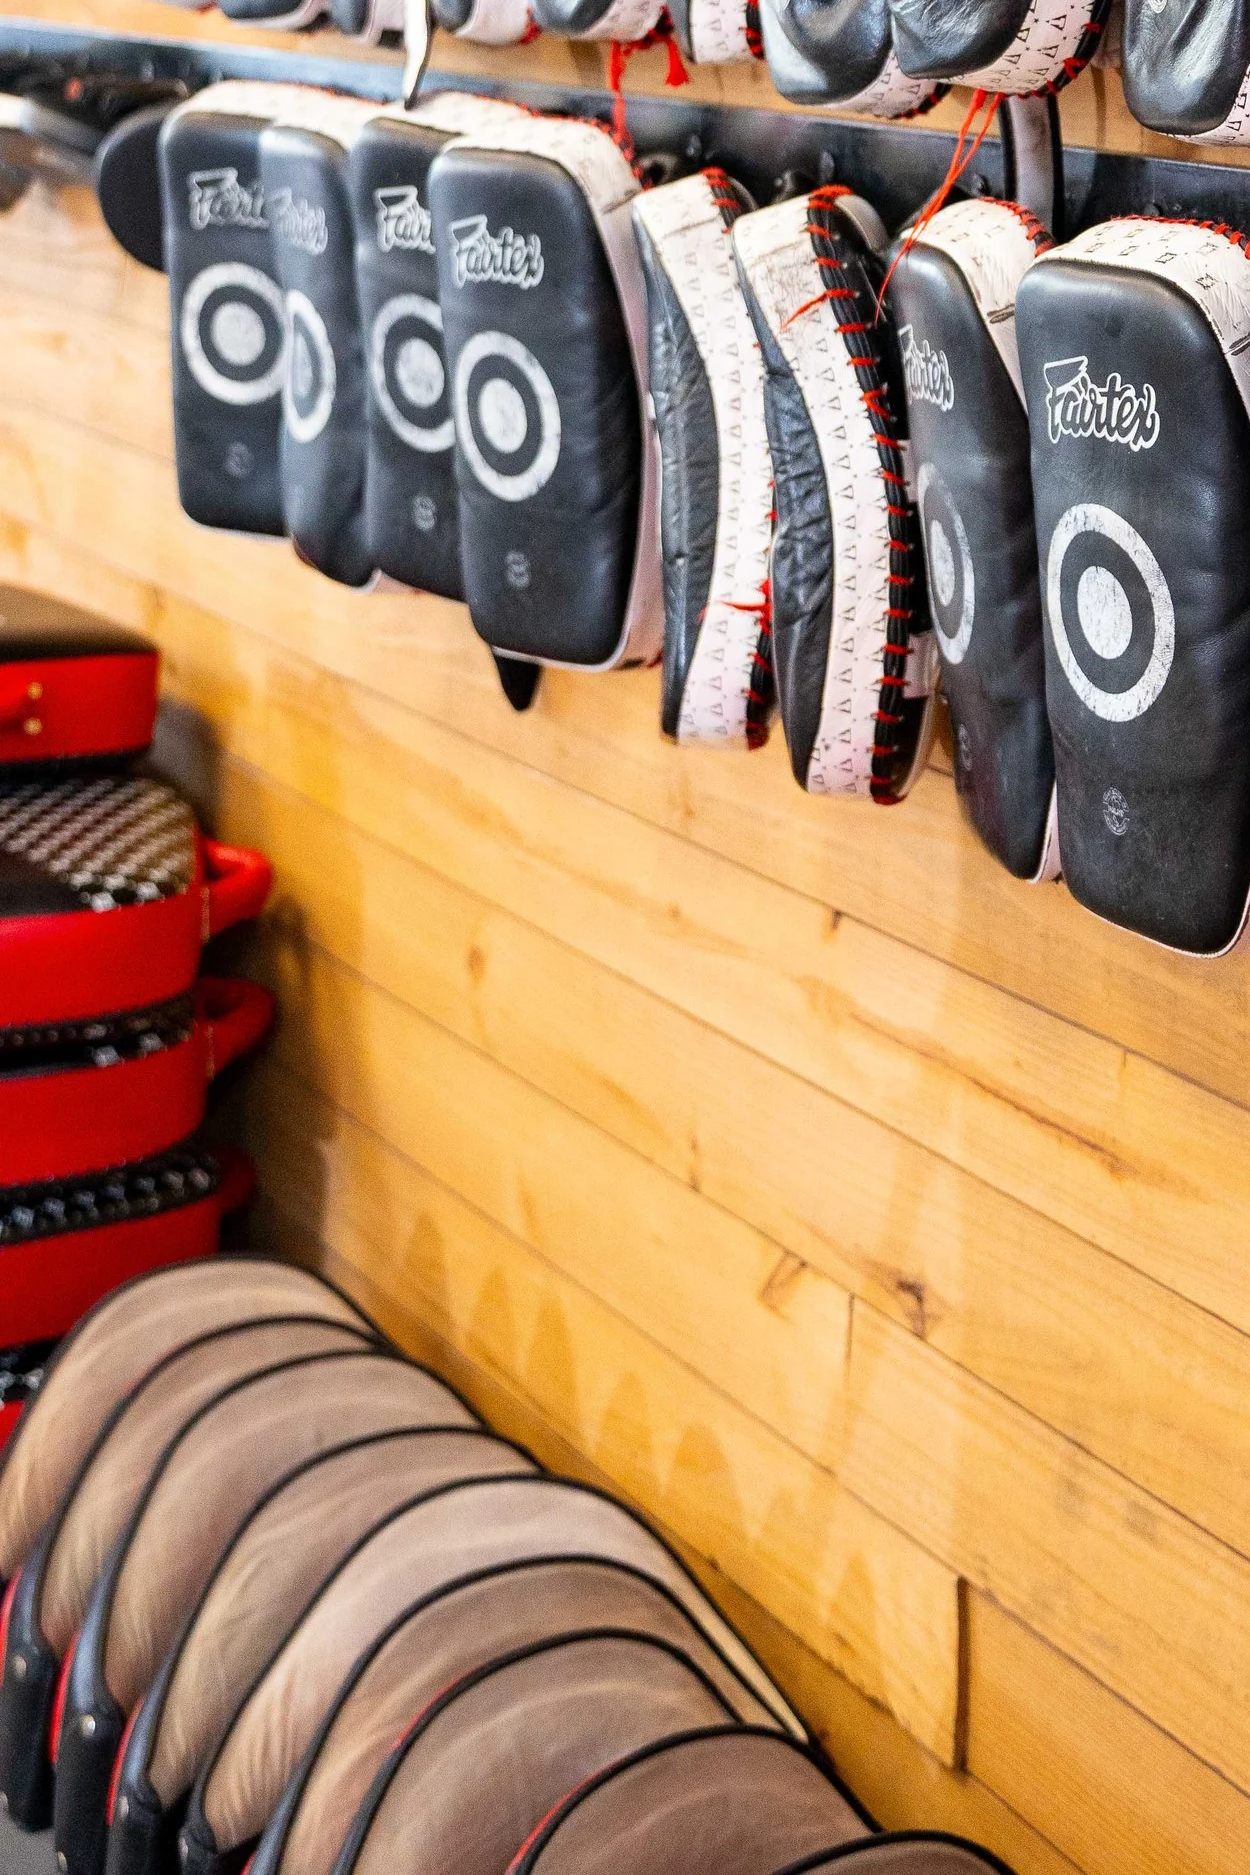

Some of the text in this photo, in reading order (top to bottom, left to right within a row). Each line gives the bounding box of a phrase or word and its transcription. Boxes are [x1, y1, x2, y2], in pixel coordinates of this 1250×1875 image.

[373, 185, 437, 253] Fair
[449, 213, 545, 290] Fairtex
[1043, 355, 1161, 453] Fairtex
